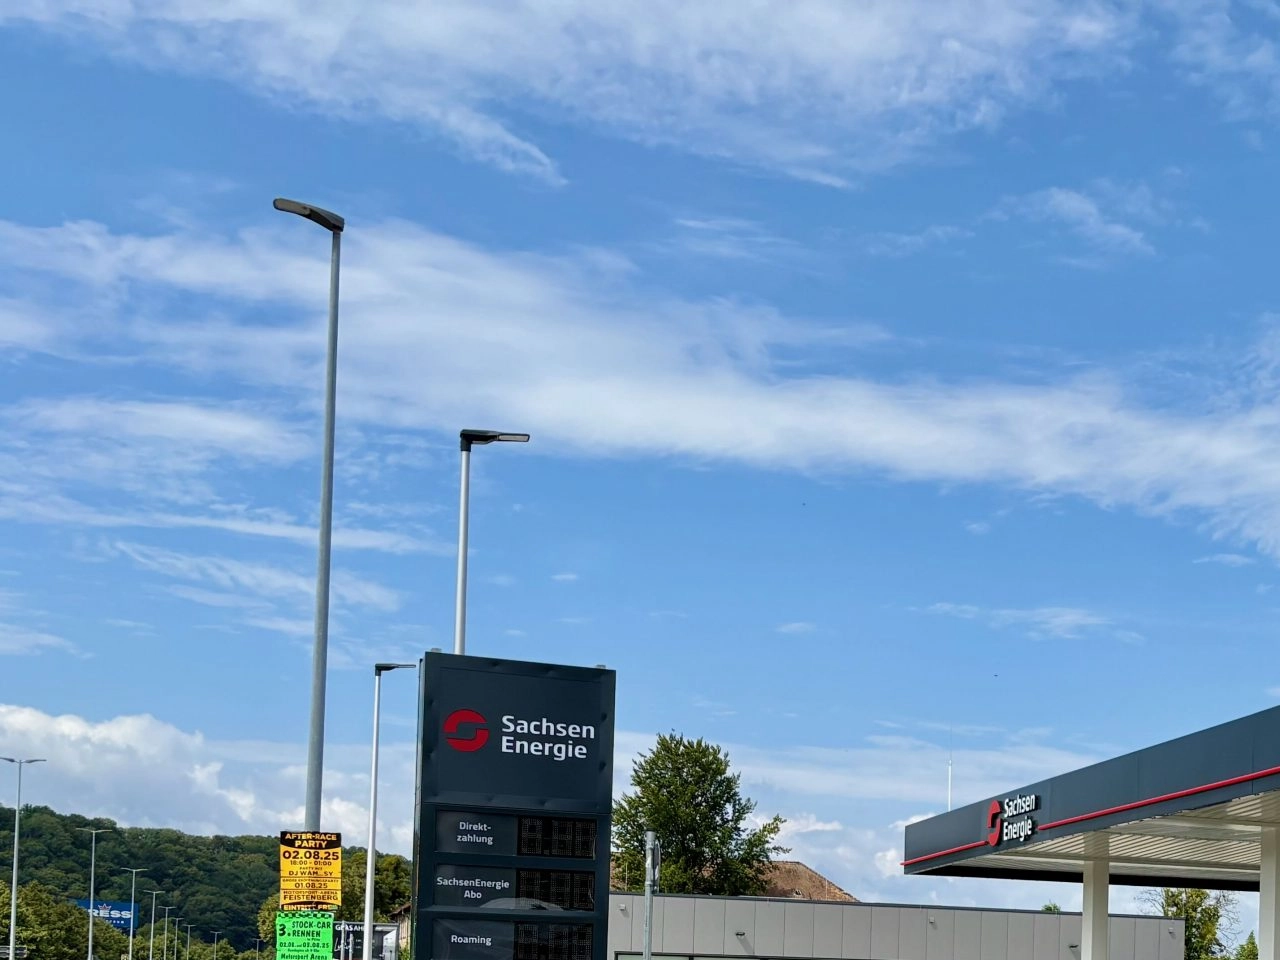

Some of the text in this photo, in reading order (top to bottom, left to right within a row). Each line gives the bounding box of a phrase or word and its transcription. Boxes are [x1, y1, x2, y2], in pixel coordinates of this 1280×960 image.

[501, 715, 595, 739] Sachsen
[501, 736, 588, 761] Energie
[1004, 793, 1035, 818] Sachsen
[459, 821, 492, 832] Direkt-
[1003, 816, 1032, 842] Energie
[457, 834, 494, 845] zahlung
[283, 850, 339, 860] 02.08.25
[436, 877, 510, 890] SachsenEnergie
[464, 890, 482, 899] Abo
[278, 923, 291, 936] 3.
[451, 934, 492, 946] Roaming
